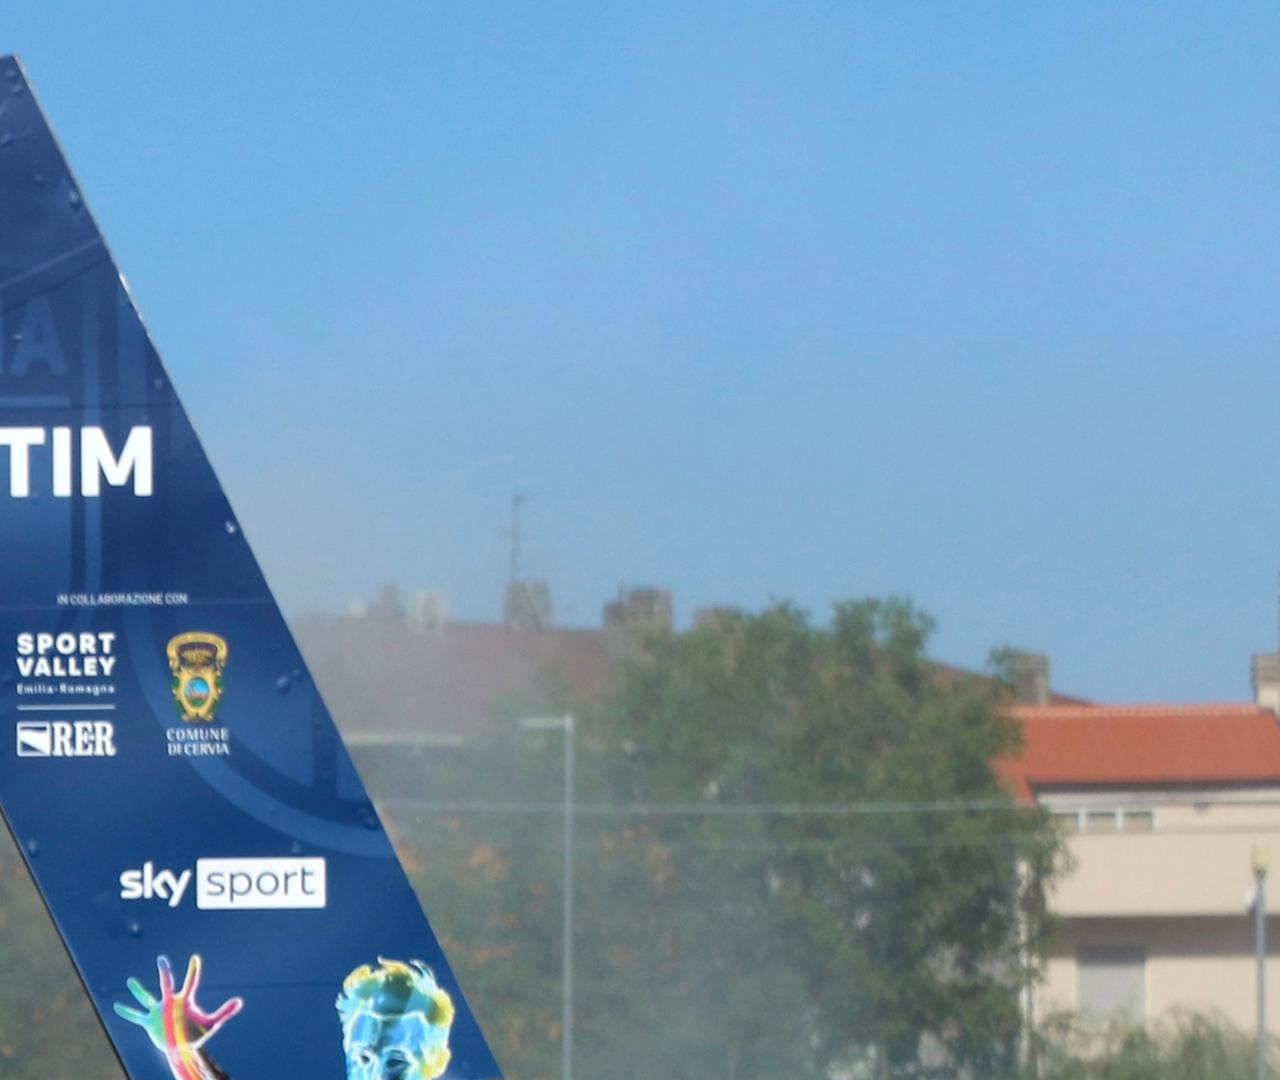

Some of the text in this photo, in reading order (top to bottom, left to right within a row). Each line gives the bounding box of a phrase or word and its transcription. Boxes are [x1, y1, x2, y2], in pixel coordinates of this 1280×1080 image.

[165, 592, 188, 605] CON
[17, 633, 115, 655] SPORT
[16, 657, 115, 676] VALLEY
[17, 684, 115, 696] Emilia-Romagna
[52, 721, 116, 756] RER
[166, 728, 229, 741] COMUNE
[168, 743, 229, 756] DI CERVIA
[119, 861, 315, 907] sky sport
